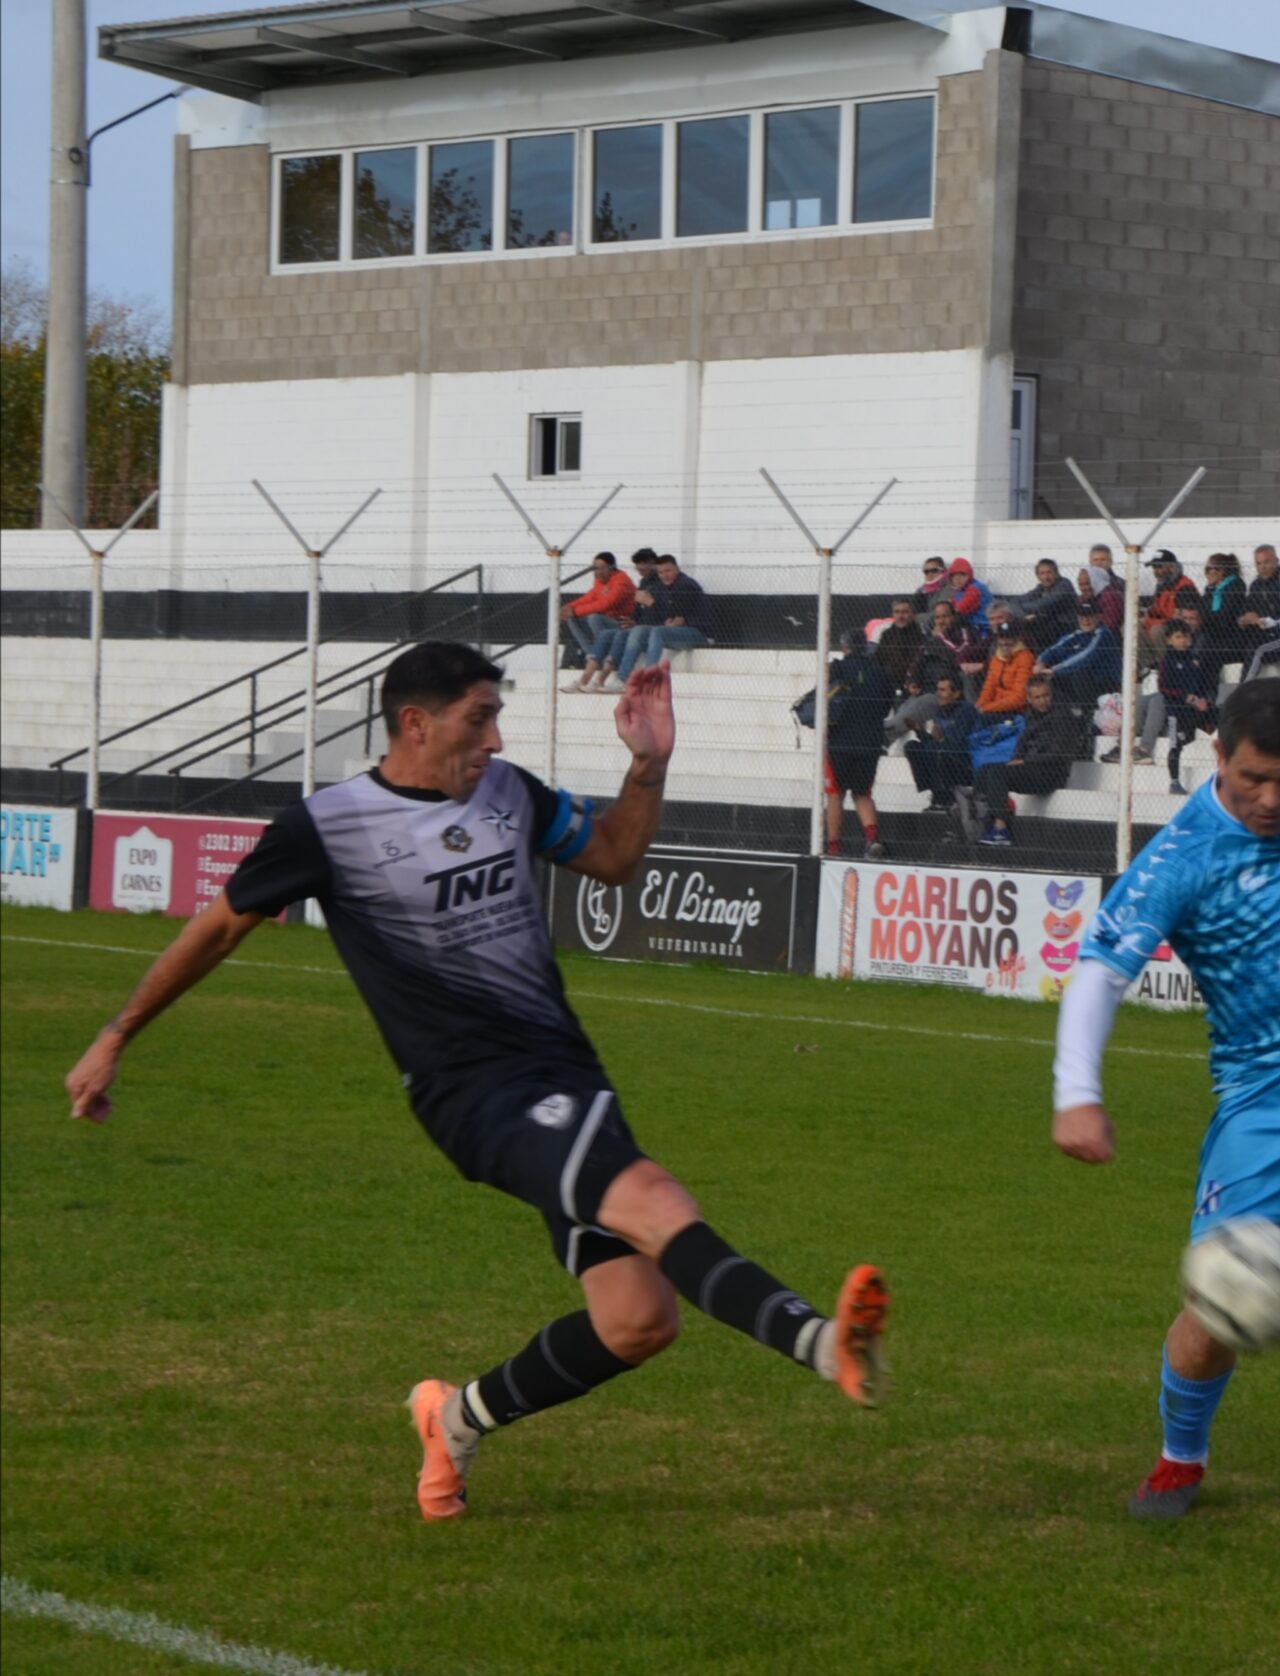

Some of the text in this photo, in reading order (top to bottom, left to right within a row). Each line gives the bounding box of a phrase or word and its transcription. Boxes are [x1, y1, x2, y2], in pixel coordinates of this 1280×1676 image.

[129, 848, 157, 866] EXPO
[121, 874, 162, 892] CARNES
[423, 849, 516, 914] TNG
[874, 871, 1018, 925] CARLOS
[640, 869, 679, 919] El
[675, 871, 762, 943] Linaje
[648, 936, 743, 957] VETERINARIA
[869, 918, 1018, 969] MOYANO
[921, 965, 968, 981] FERRETERIA
